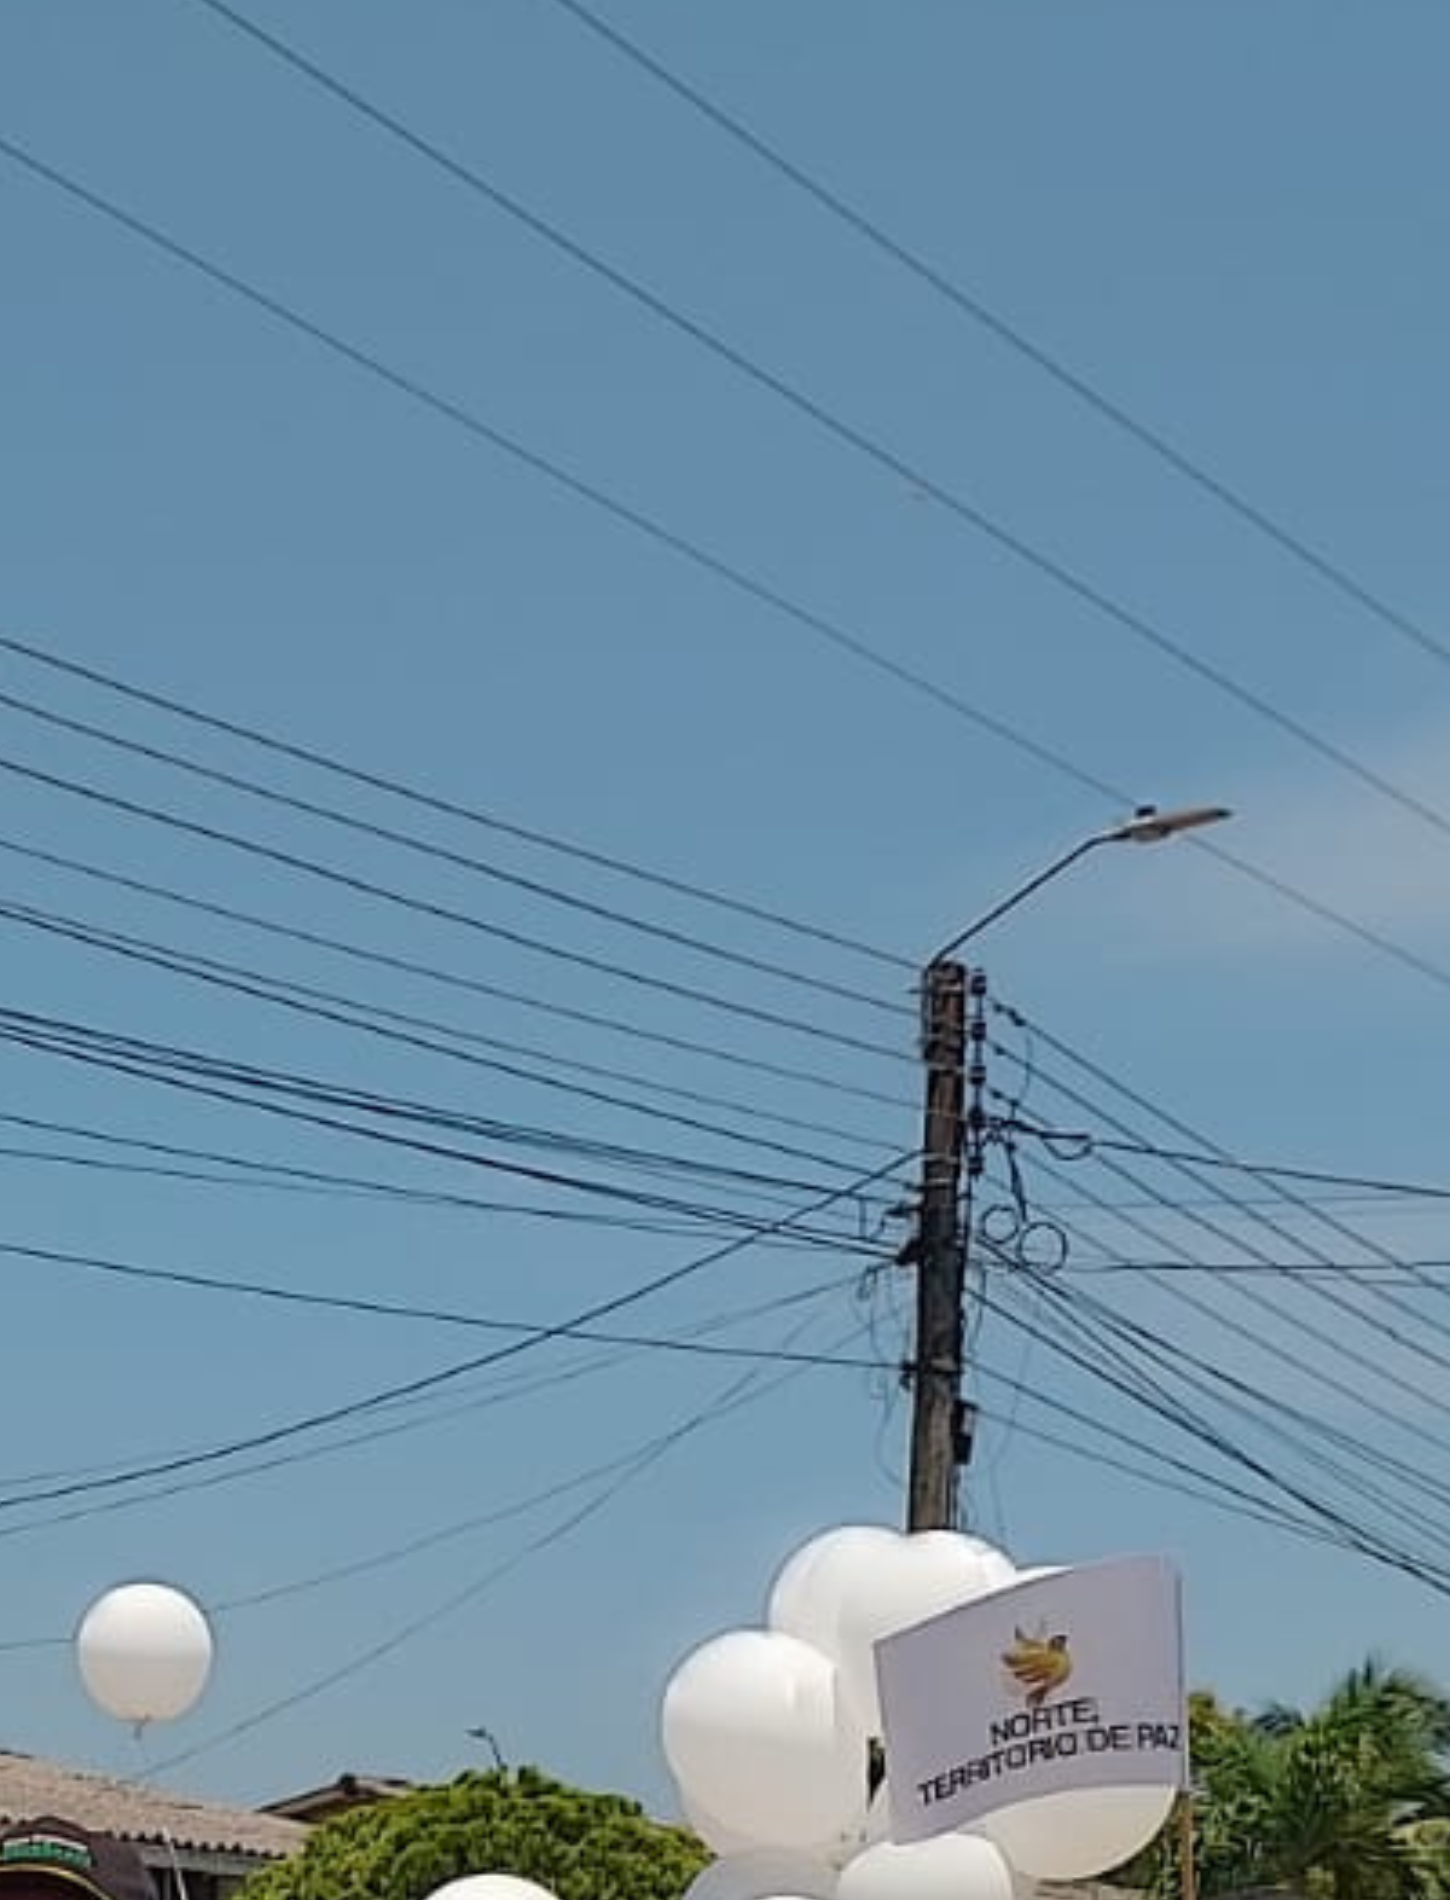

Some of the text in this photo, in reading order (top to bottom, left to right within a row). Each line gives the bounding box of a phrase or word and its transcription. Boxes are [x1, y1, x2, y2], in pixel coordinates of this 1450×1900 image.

[917, 1723, 1180, 1804] TERRITORIO DE PAZ
